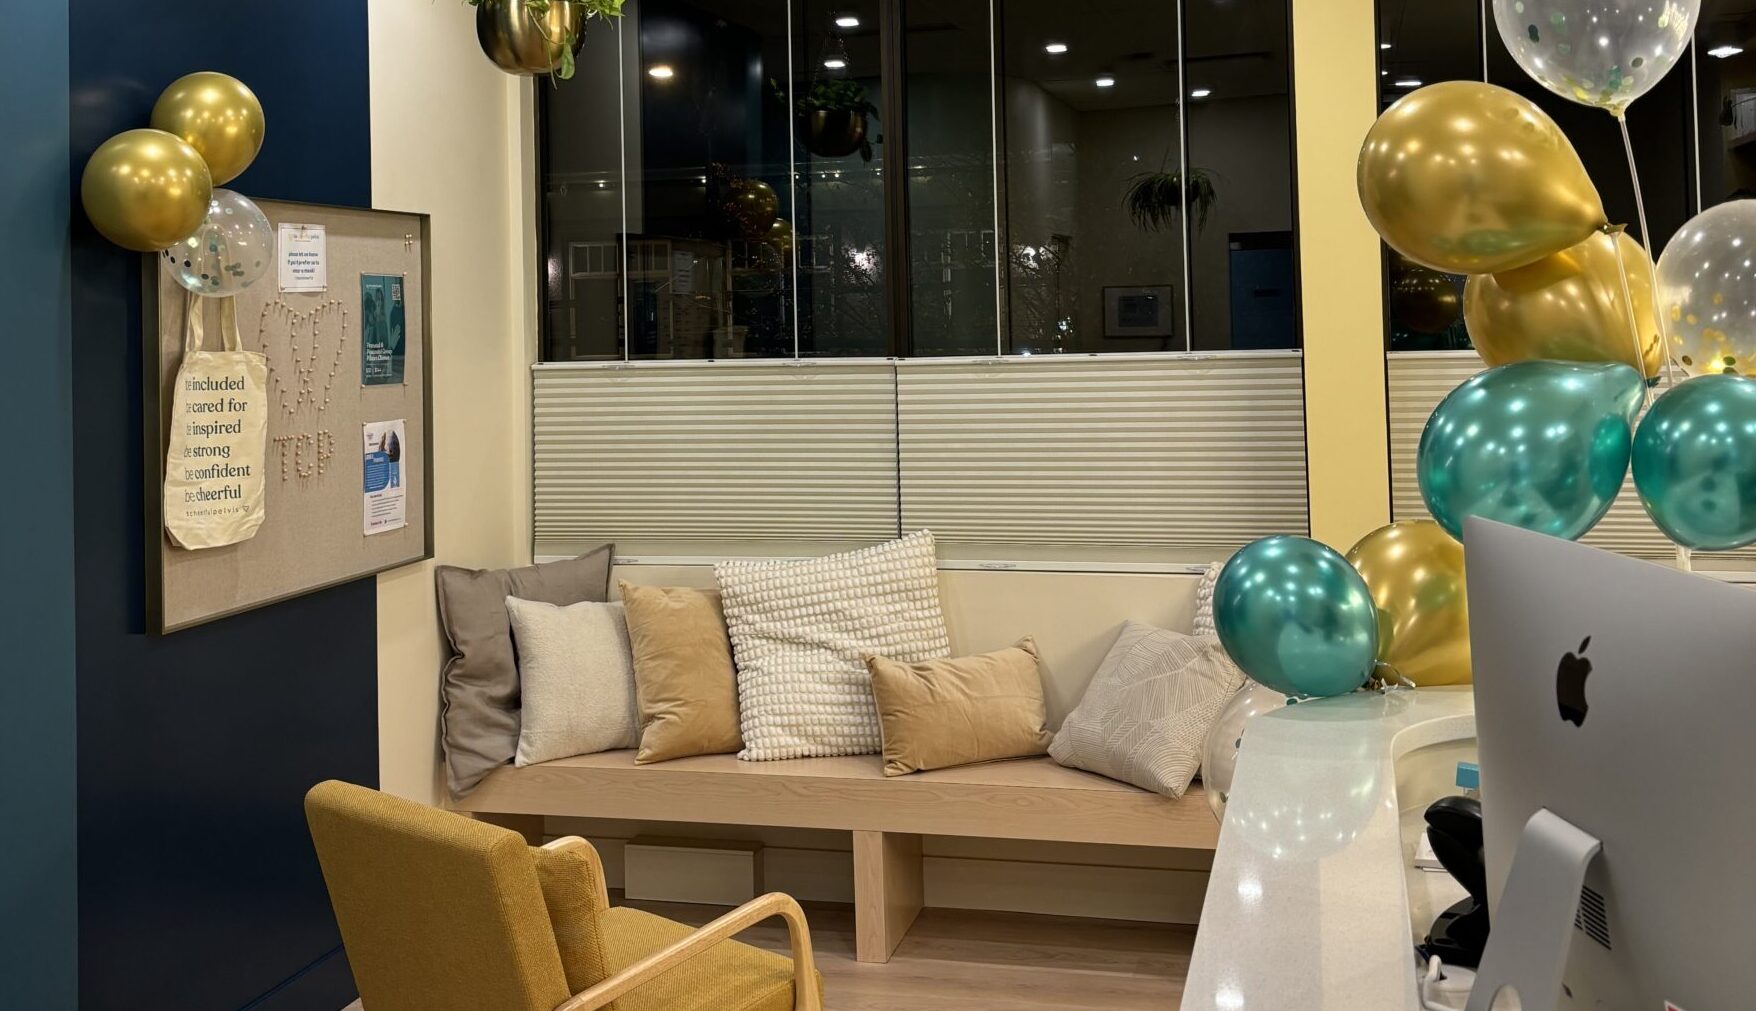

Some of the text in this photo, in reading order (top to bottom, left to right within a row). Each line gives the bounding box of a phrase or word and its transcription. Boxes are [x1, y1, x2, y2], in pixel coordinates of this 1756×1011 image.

[192, 376, 245, 391] included
[192, 398, 224, 413] cared
[228, 398, 248, 412] for
[192, 419, 241, 438] inspired
[192, 445, 231, 459] strong
[184, 463, 251, 480] be confident
[196, 484, 242, 501] cheerful
